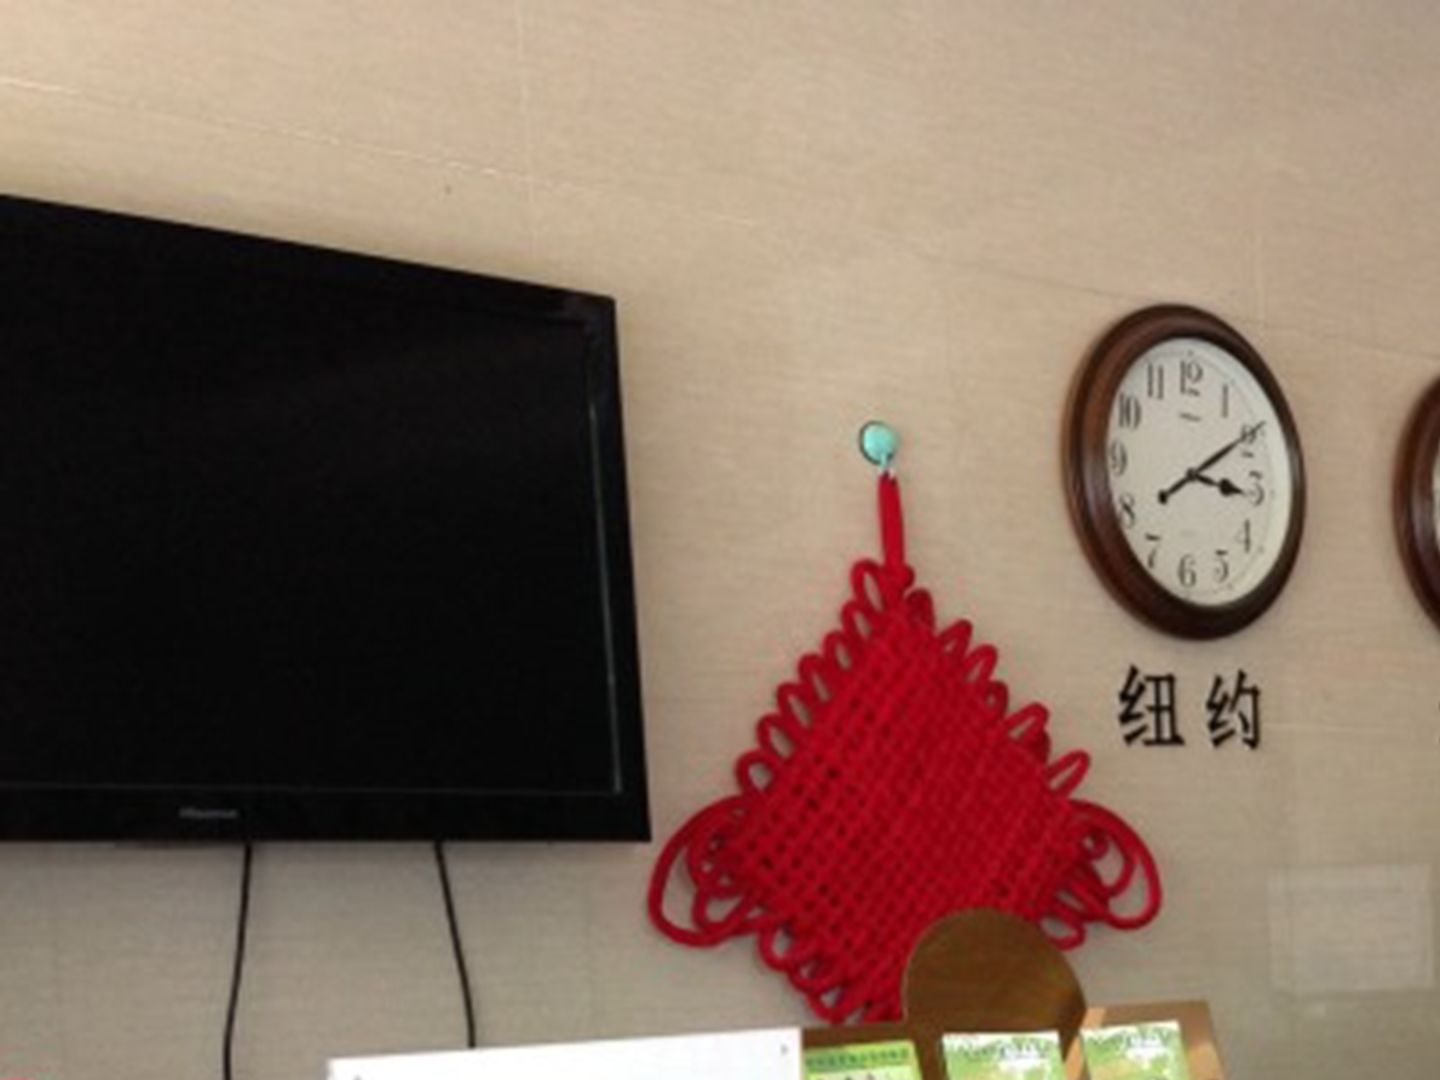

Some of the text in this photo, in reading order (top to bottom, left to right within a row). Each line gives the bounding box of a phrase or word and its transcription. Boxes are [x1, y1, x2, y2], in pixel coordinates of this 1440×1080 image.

[1147, 362, 1164, 399] 11
[1180, 361, 1203, 396] 12
[1118, 392, 1142, 429] 10
[1111, 442, 1127, 476] 9
[1146, 533, 1162, 568] 7
[1215, 549, 1229, 582] 5
[1178, 555, 1197, 589] 6
[1119, 665, 1260, 749] 纽约
